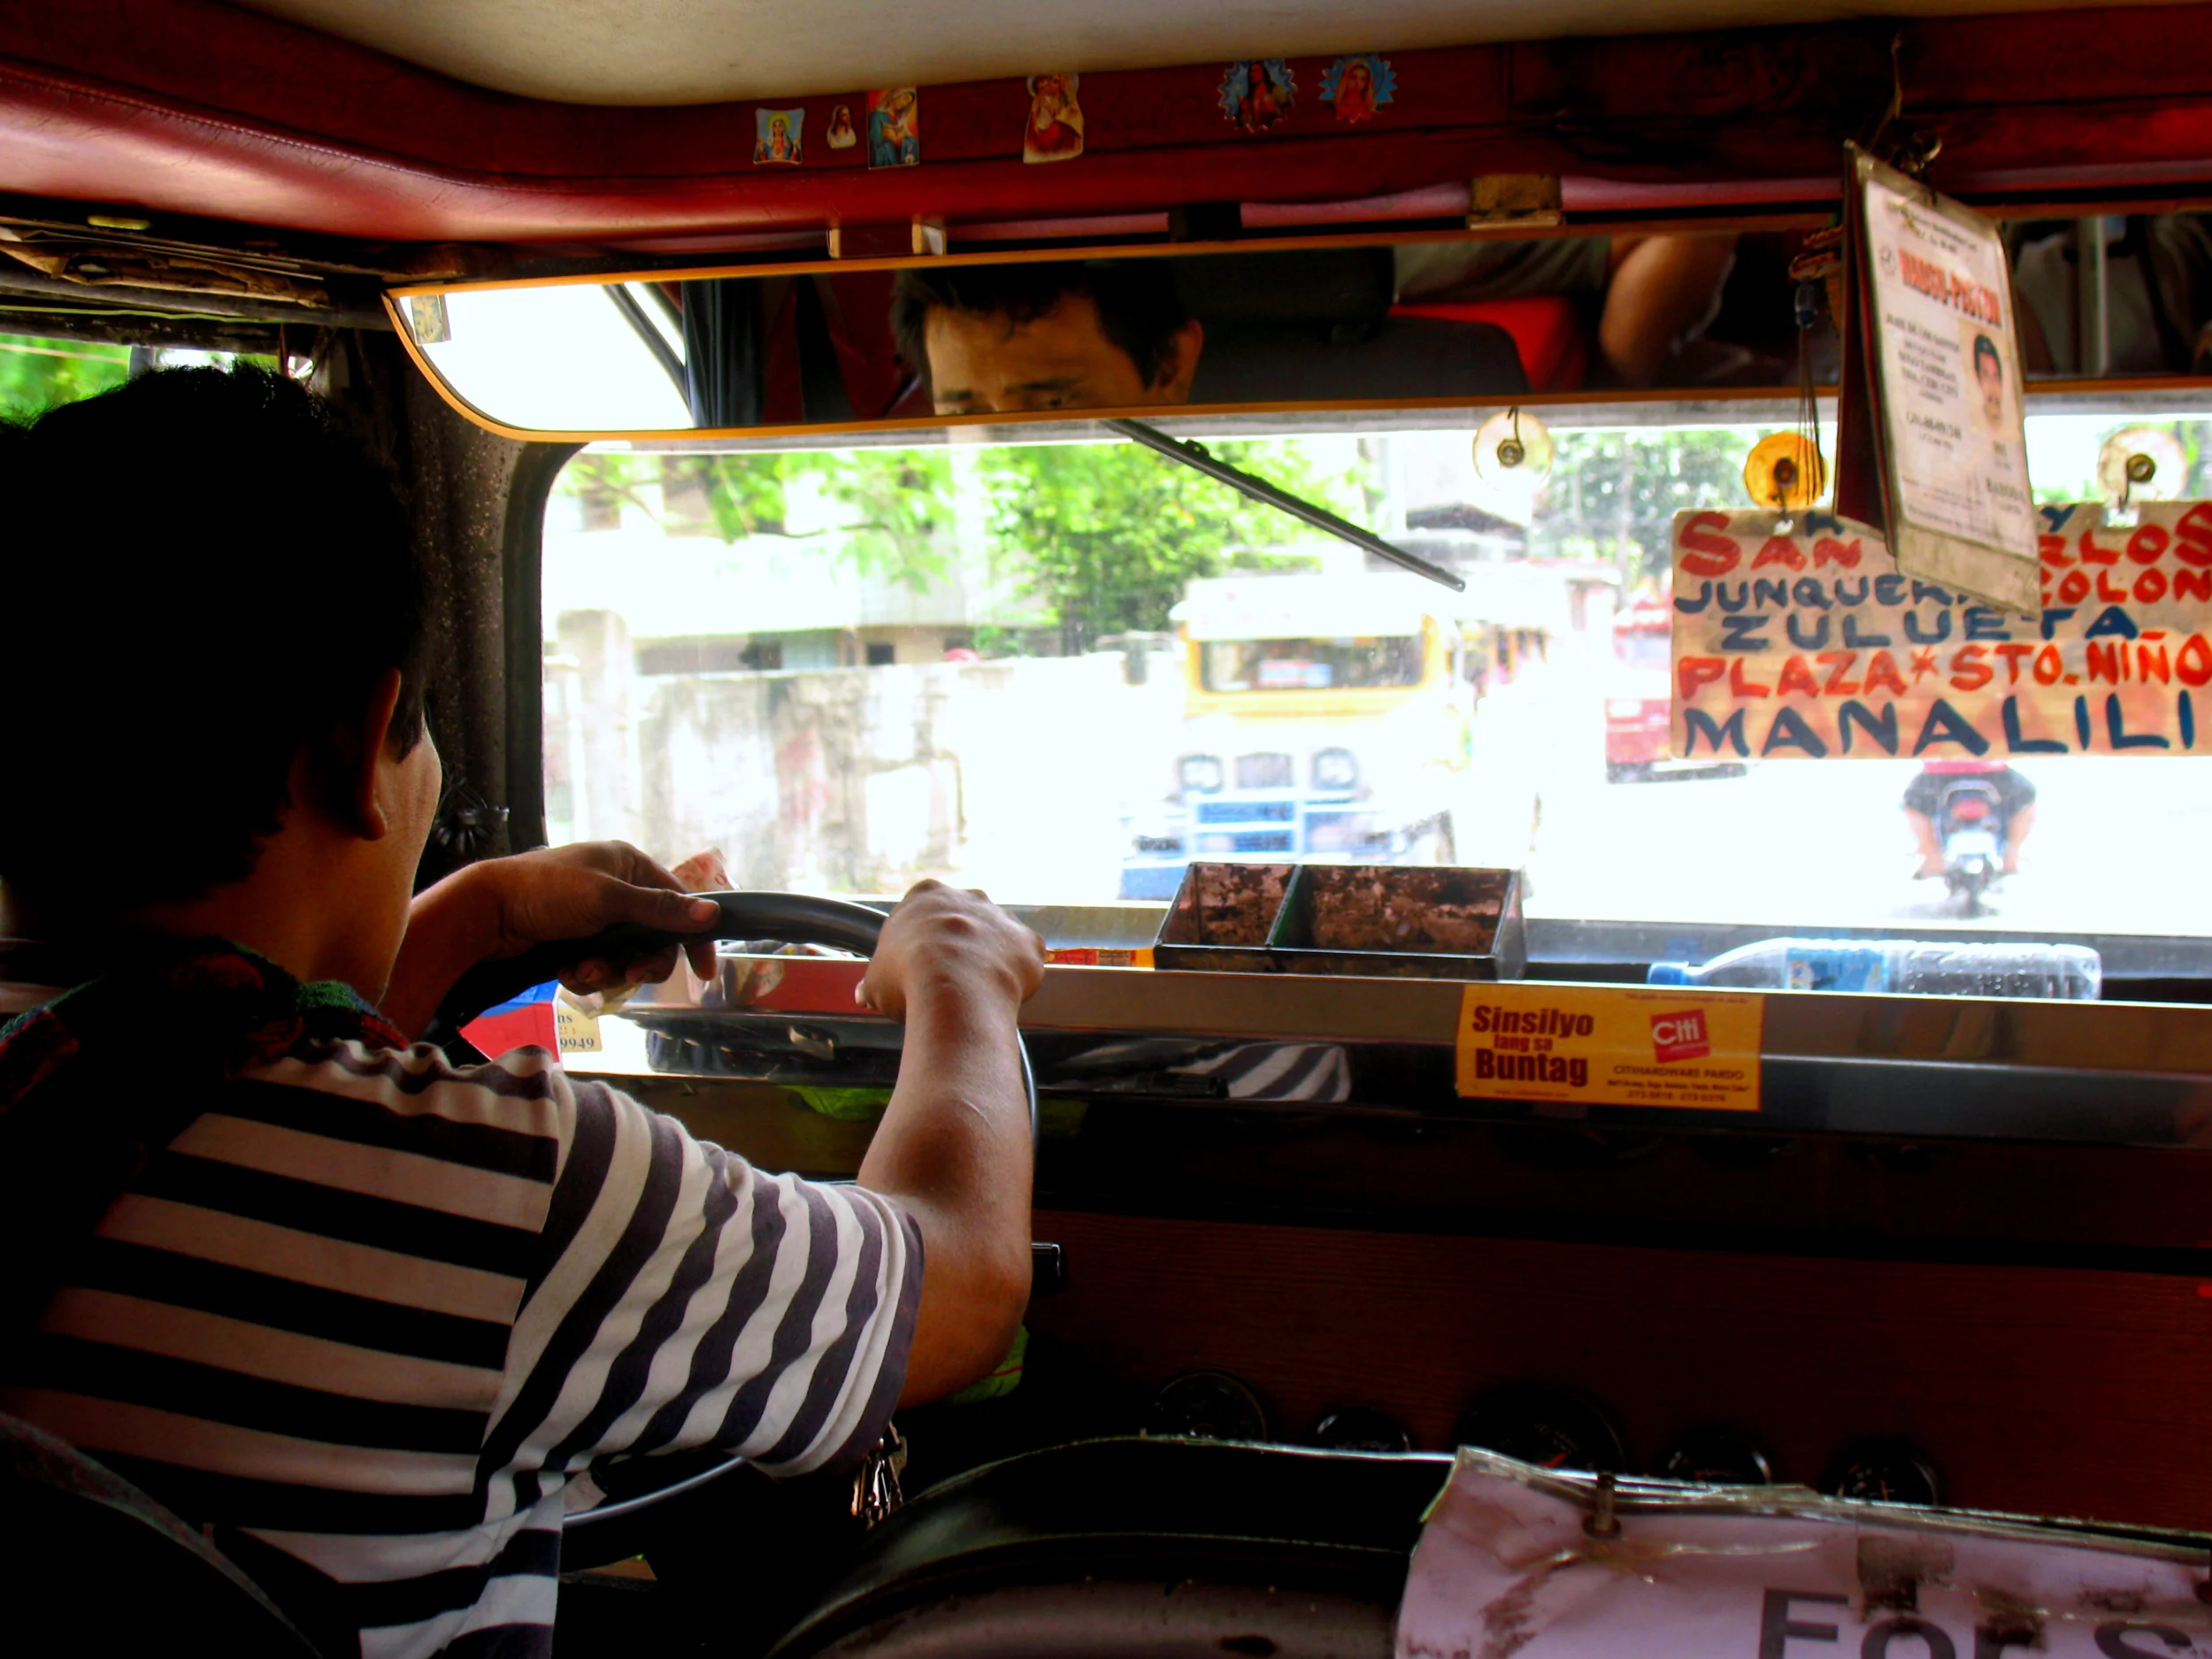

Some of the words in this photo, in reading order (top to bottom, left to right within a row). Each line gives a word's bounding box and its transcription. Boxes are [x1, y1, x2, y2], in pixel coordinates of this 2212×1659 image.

[1674, 573, 1970, 613] JUNQUER
[1720, 605, 2139, 651] ZULUETA
[1678, 649, 1908, 700] PLAZA
[1684, 689, 2195, 757] MANALILI
[1472, 1005, 1594, 1039] Sinsilyo
[1653, 1017, 1700, 1045] Citi
[1476, 1048, 1588, 1087] Buntag
